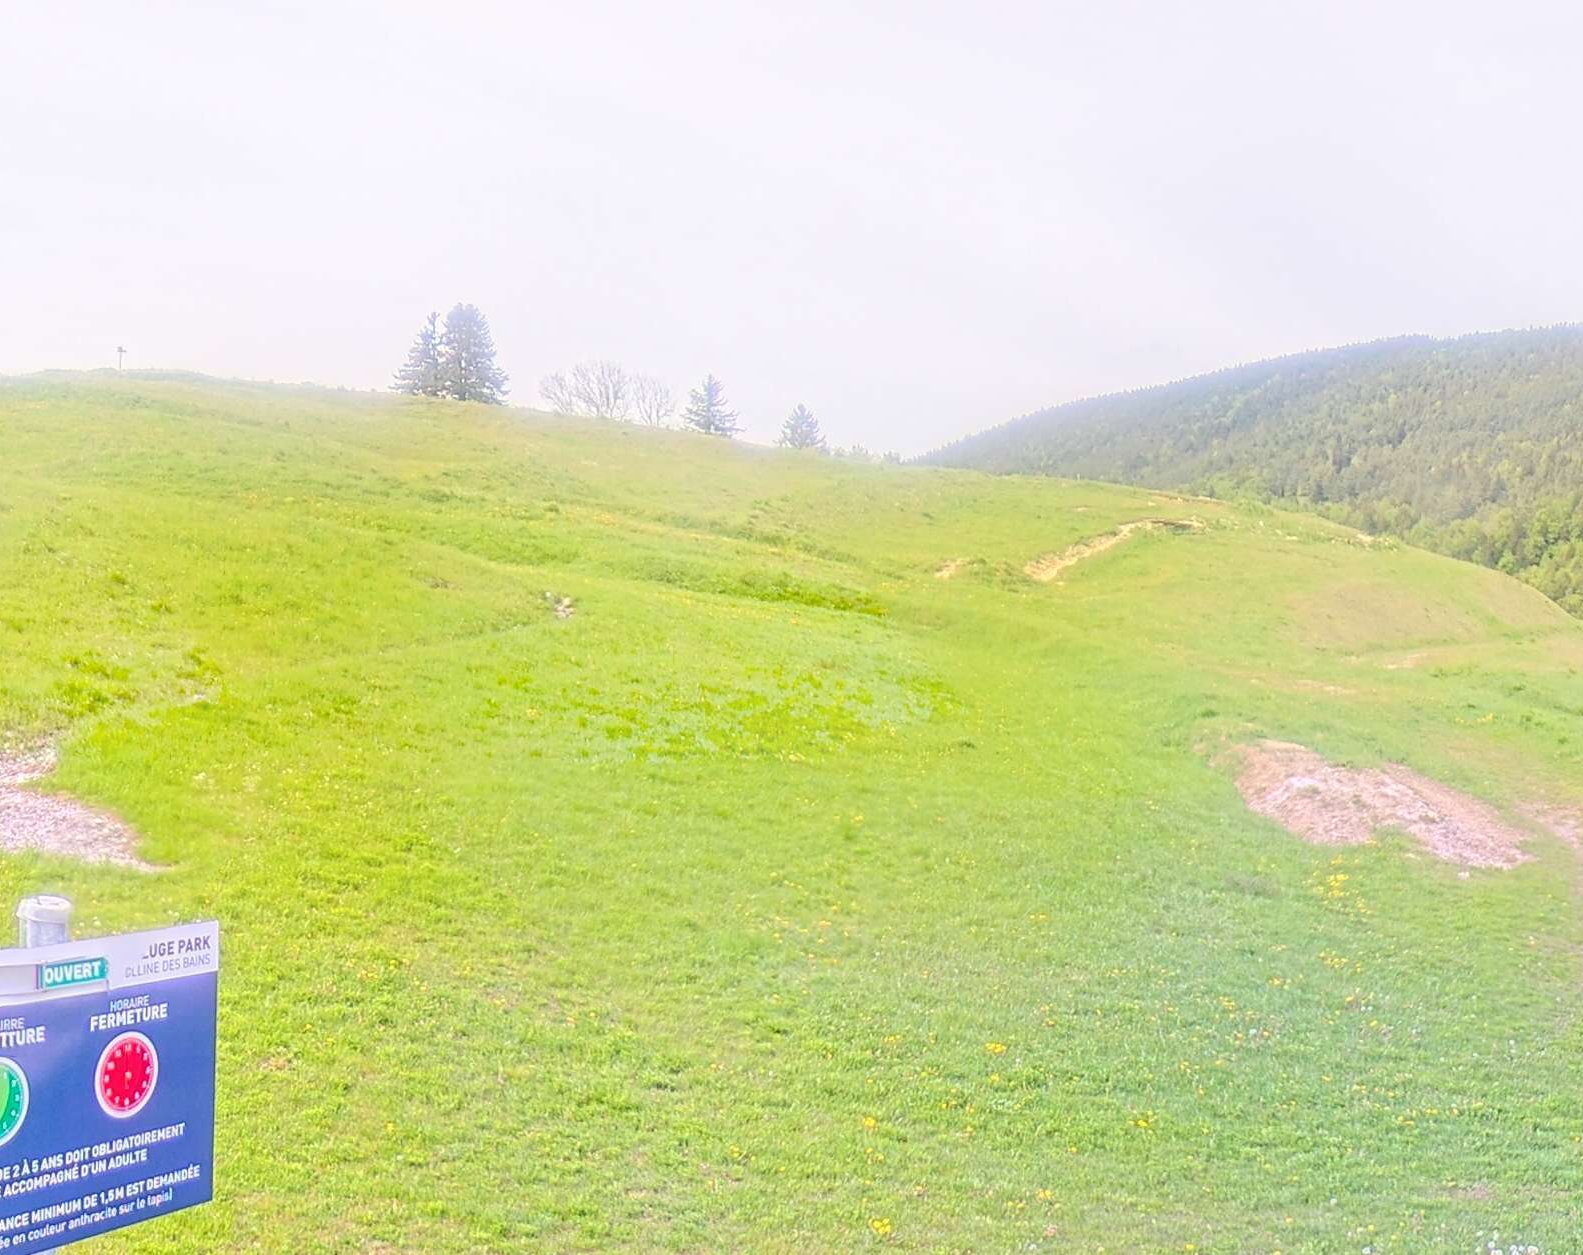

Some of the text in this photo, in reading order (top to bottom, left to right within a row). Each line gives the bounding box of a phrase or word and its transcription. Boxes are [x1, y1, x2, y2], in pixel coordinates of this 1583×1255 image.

[178, 935, 211, 953] PARK
[44, 961, 102, 985] OUVERT
[162, 958, 181, 975] DES
[183, 953, 211, 970] BAINS
[90, 1003, 169, 1033] FERMETURE
[110, 995, 150, 1013] HORAIRE
[12, 1164, 20, 1178] 2
[31, 1159, 39, 1173] 5
[40, 1153, 64, 1171] ANS
[65, 1147, 90, 1163] DOIT
[91, 1122, 186, 1158] OBLIGATOIREMENT
[3, 1162, 79, 1197] ACCOMPAGNÉ
[108, 1148, 148, 1167] ADULTE
[31, 1197, 82, 1221] MINIMUM
[83, 1193, 98, 1209] DE
[126, 1180, 146, 1197] EST
[146, 1163, 201, 1190] DEMANDÉE
[12, 1232, 26, 1246] en
[27, 1219, 67, 1242] couleur
[68, 1206, 117, 1231] anthracite
[118, 1202, 135, 1216] sur
[136, 1198, 146, 1211] le
